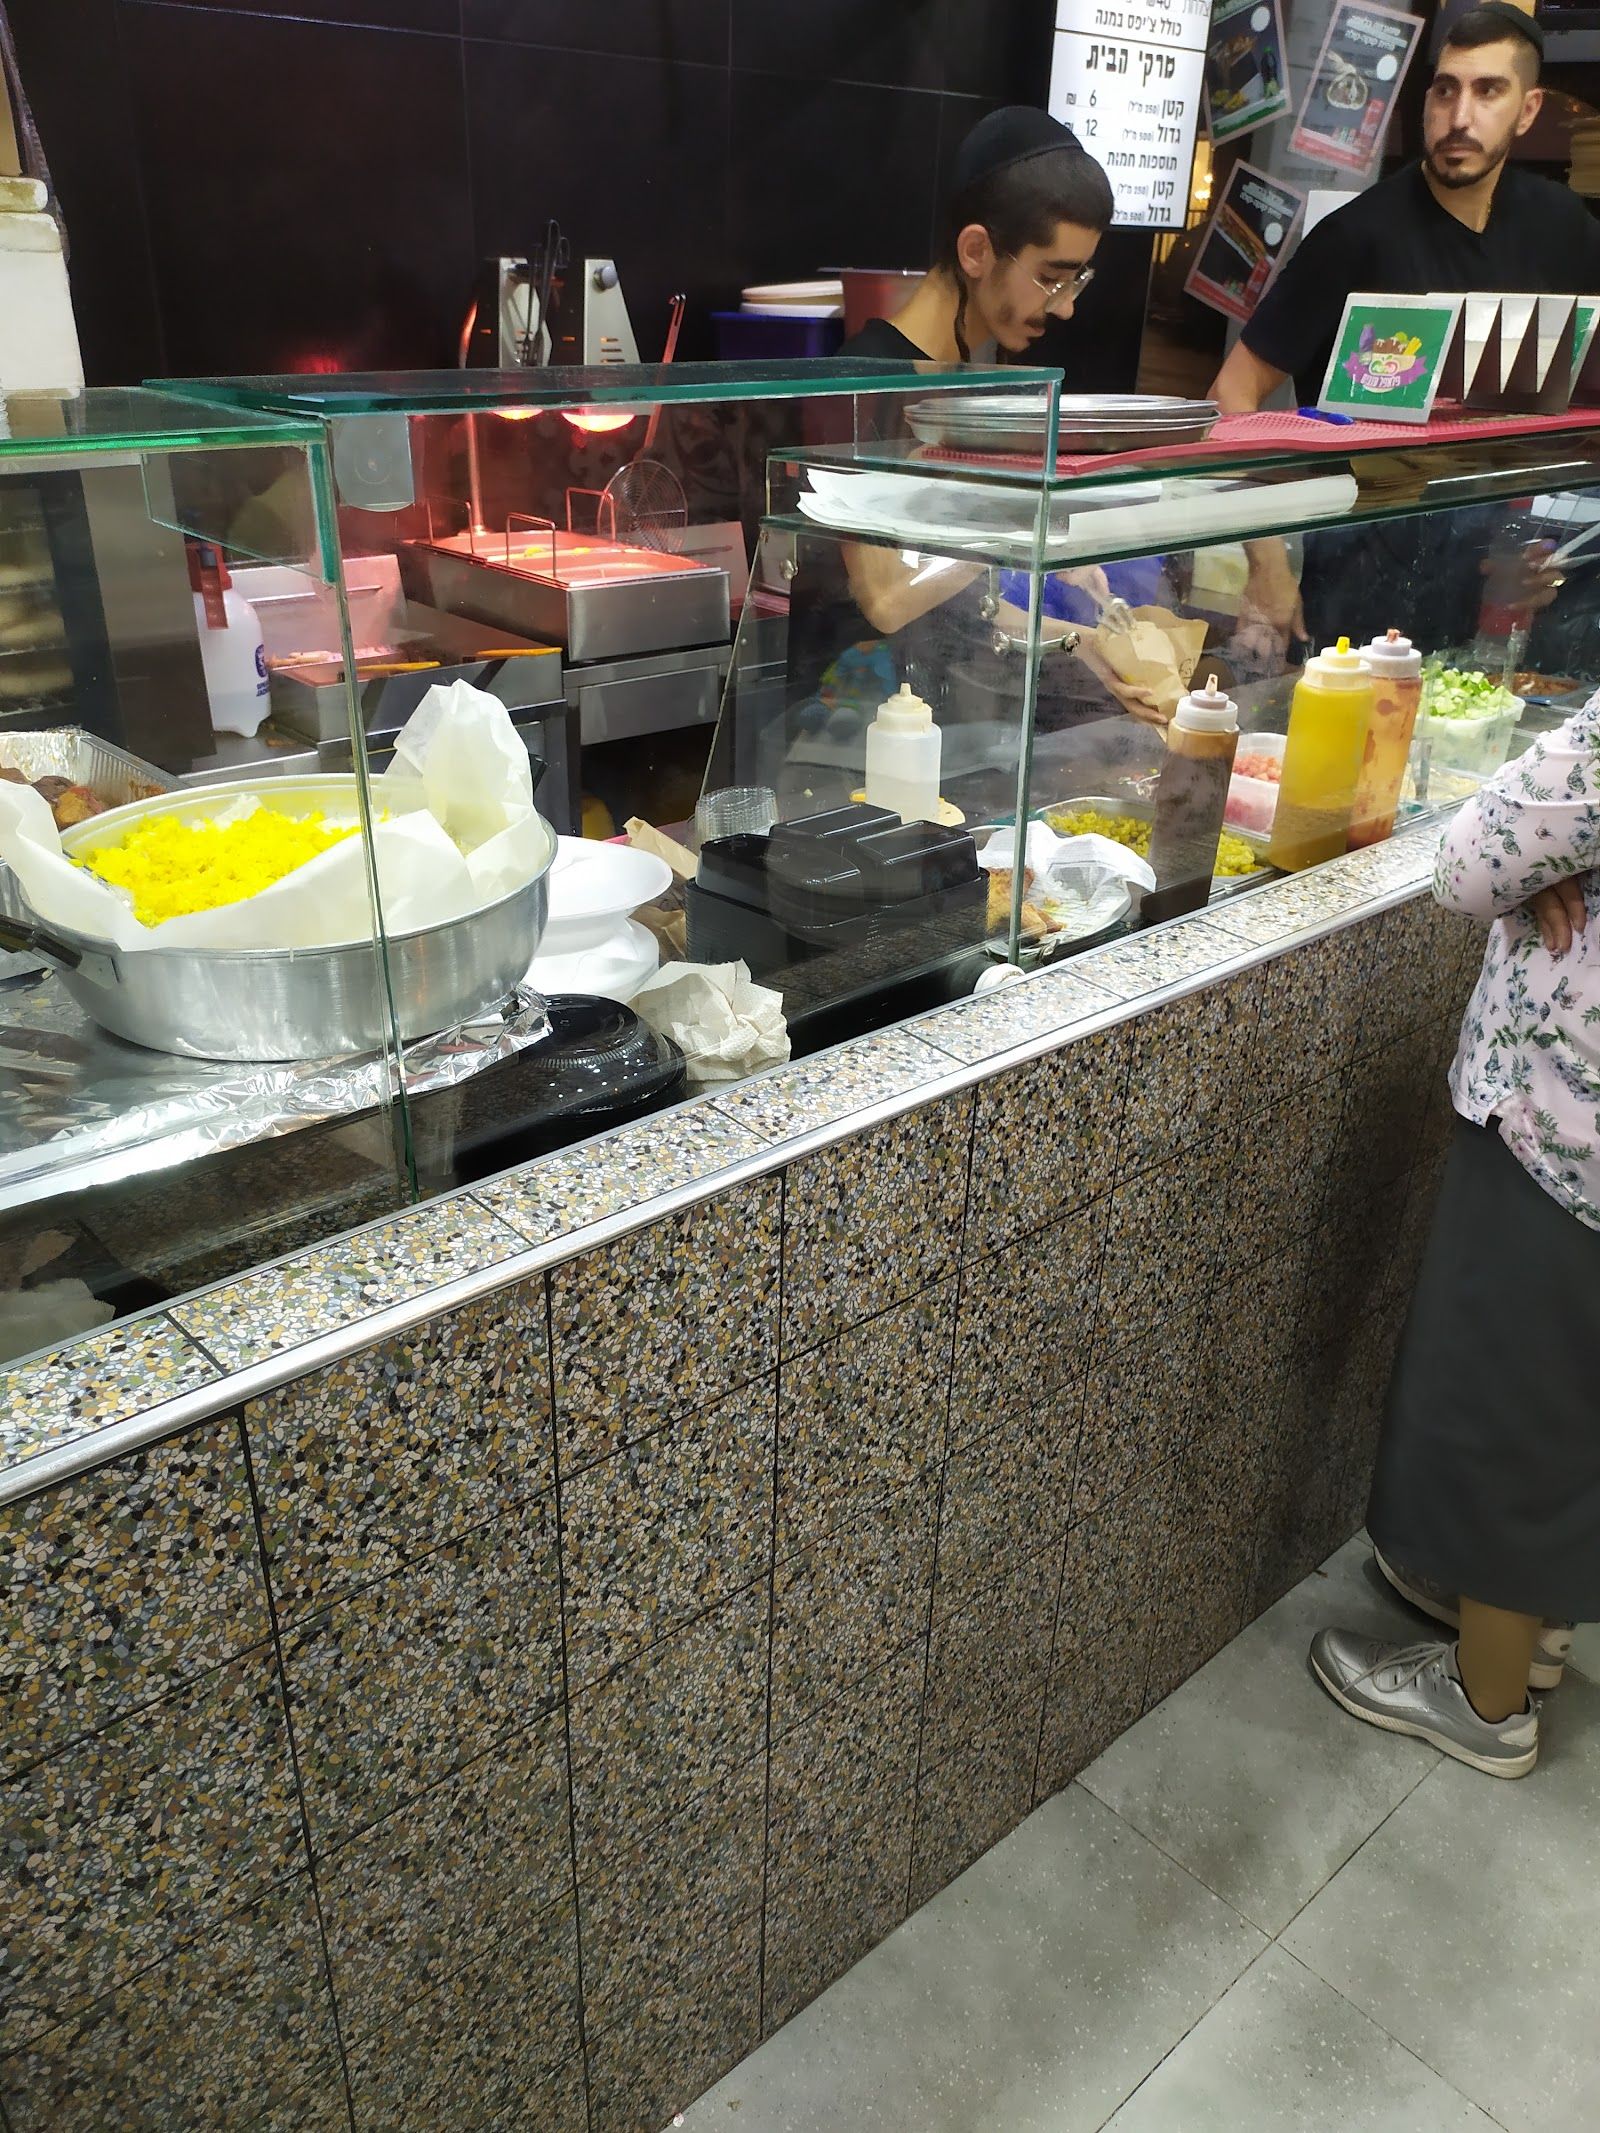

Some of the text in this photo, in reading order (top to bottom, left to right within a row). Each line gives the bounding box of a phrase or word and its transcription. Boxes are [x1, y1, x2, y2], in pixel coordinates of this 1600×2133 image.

[1095, 8, 1124, 28] במנה
[1160, 19, 1182, 37] כולל
[1085, 44, 1176, 87] מרקי הבית
[1089, 89, 1097, 107] 6
[1161, 99, 1185, 120] קטן
[1085, 118, 1098, 137] 12
[1157, 123, 1181, 145] גדול
[1138, 154, 1178, 171] תוספות
[1152, 180, 1175, 201] קטן
[1147, 203, 1172, 223] גדול
